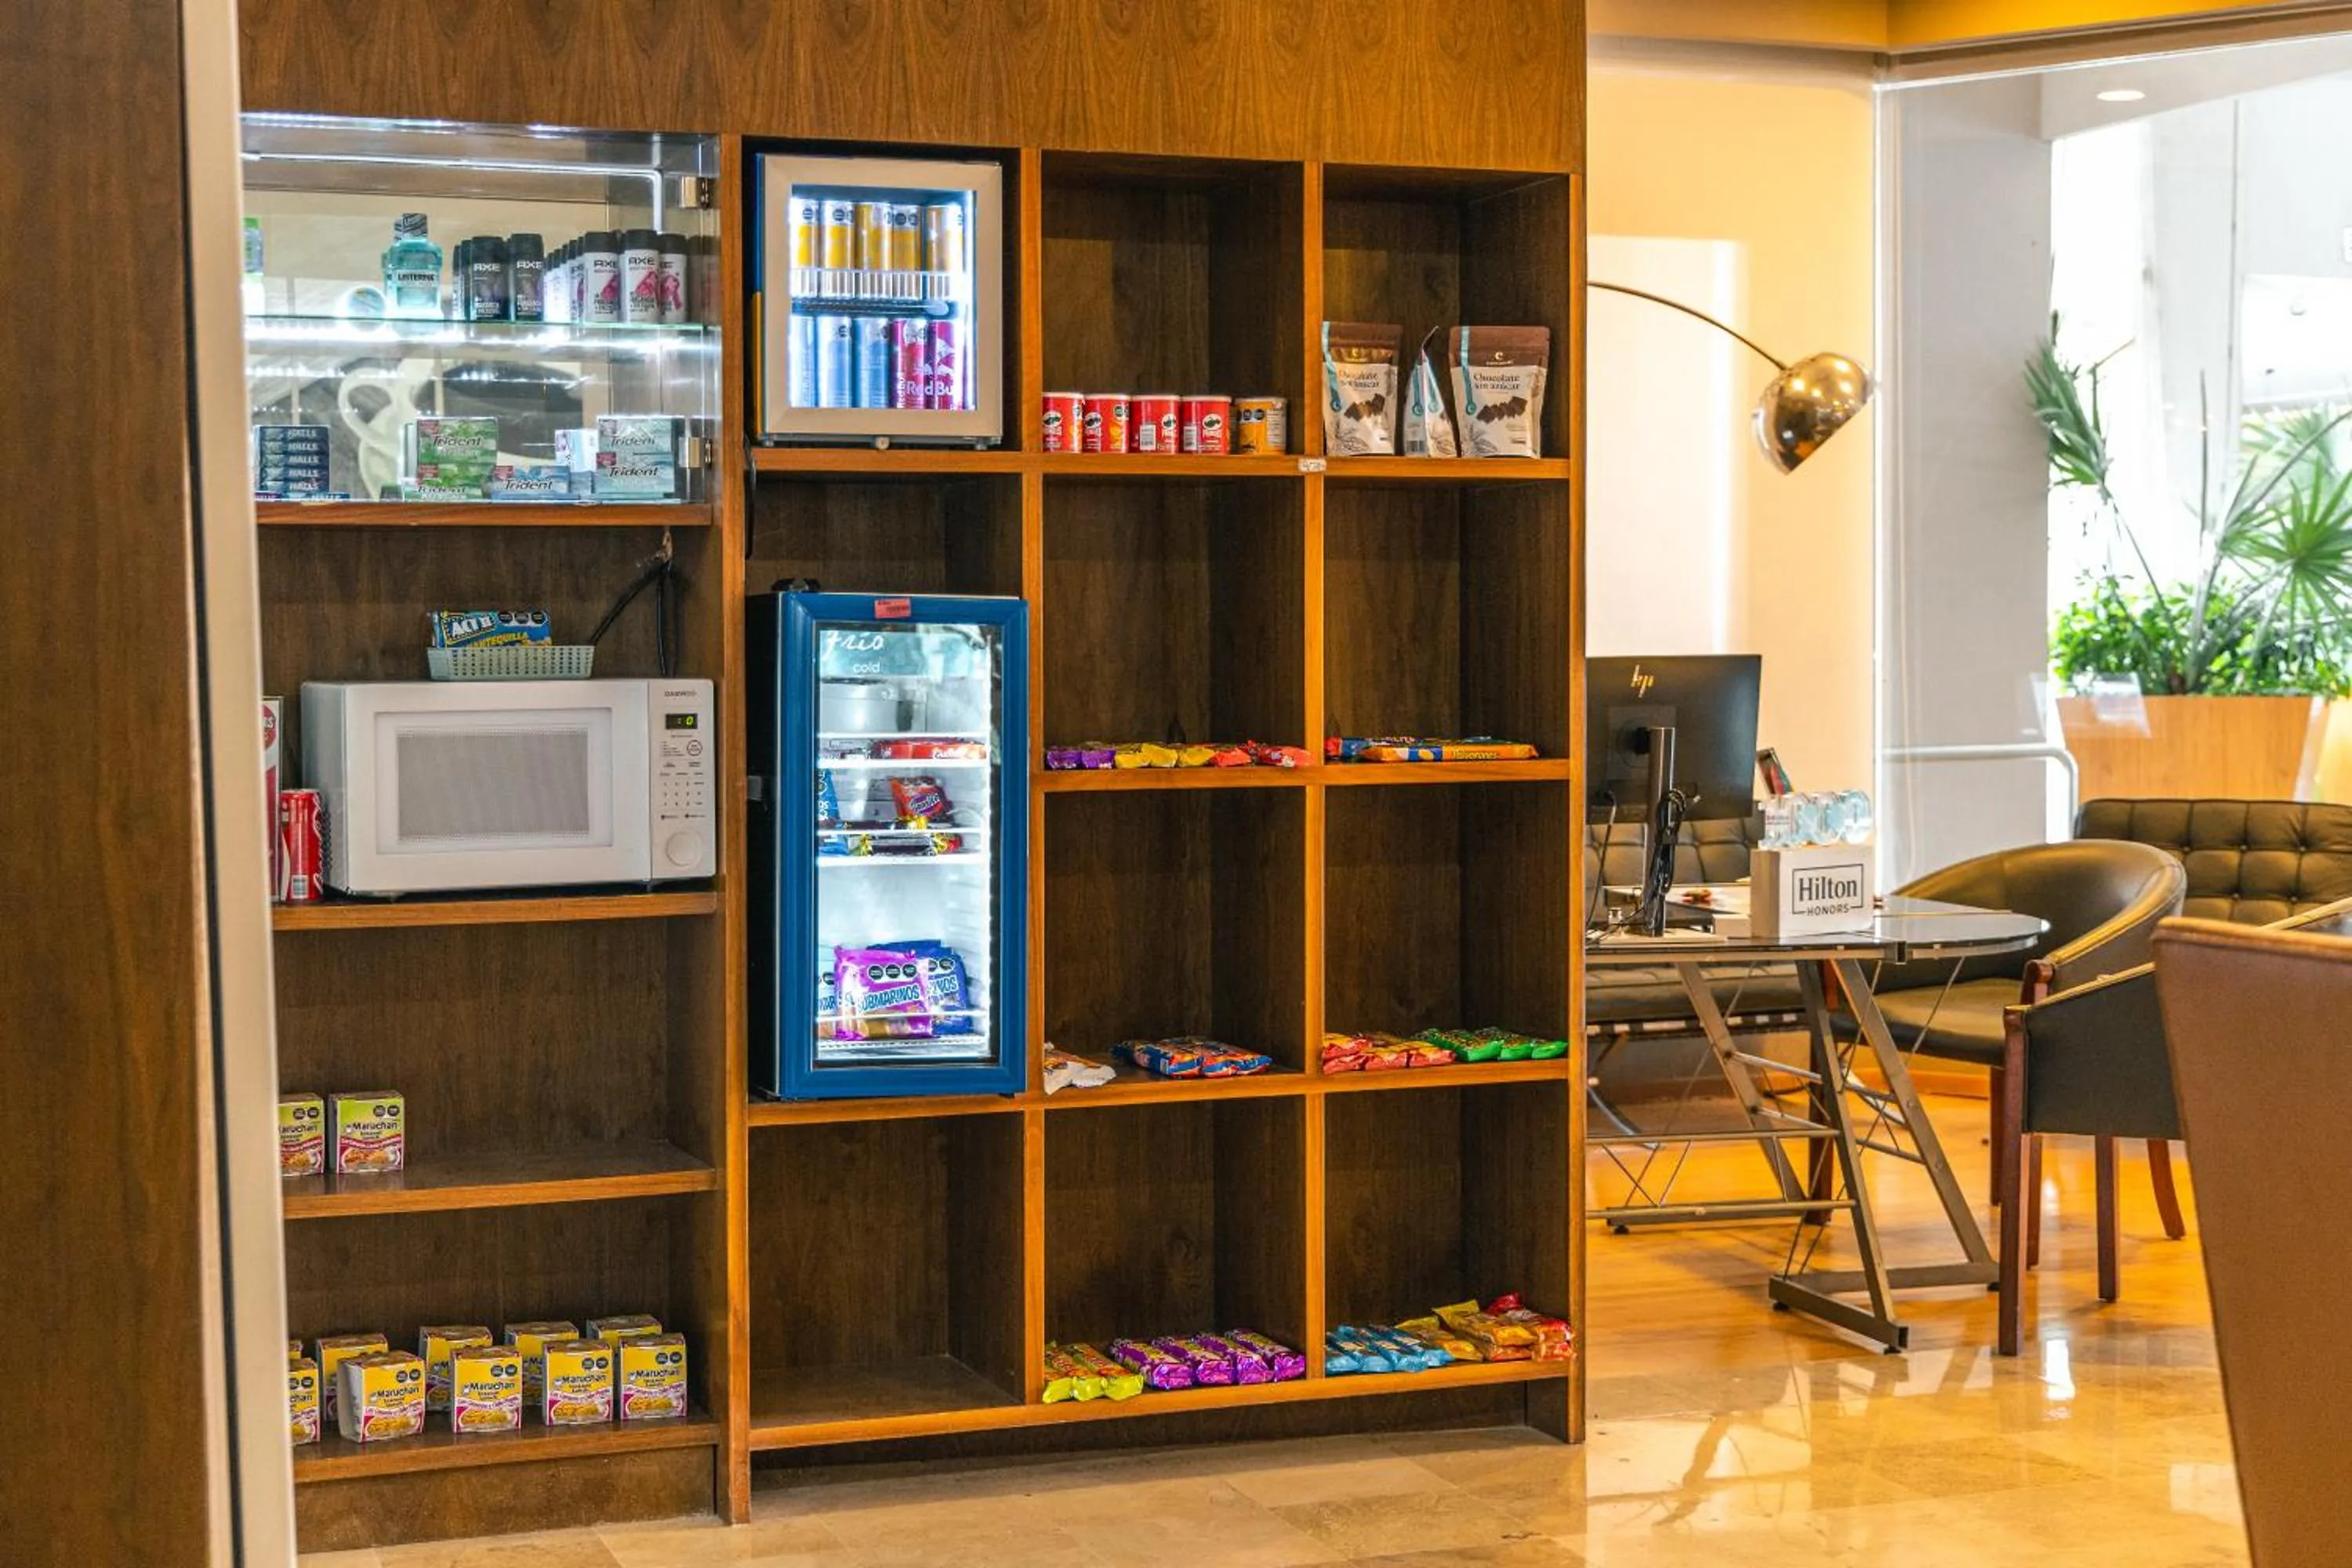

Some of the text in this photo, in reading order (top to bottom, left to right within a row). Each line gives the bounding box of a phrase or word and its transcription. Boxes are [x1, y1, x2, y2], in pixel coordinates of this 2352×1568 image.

[629, 256, 655, 265] AXE
[474, 263, 500, 272] AXE
[433, 434, 481, 446] Trident
[611, 436, 655, 447] Trident
[609, 466, 658, 477] Trident
[504, 479, 553, 490] Trident
[853, 662, 880, 673] cold
[1632, 665, 1653, 698] hp
[1798, 876, 1857, 902] Hilton
[1807, 905, 1849, 916] HONORS
[279, 1123, 317, 1134] aruchan
[352, 1120, 397, 1131] Maruchan
[561, 1374, 607, 1384] Maruchan
[635, 1368, 680, 1379] Maruchan
[470, 1381, 515, 1391] Maruchan
[376, 1386, 419, 1398] Maruchan
